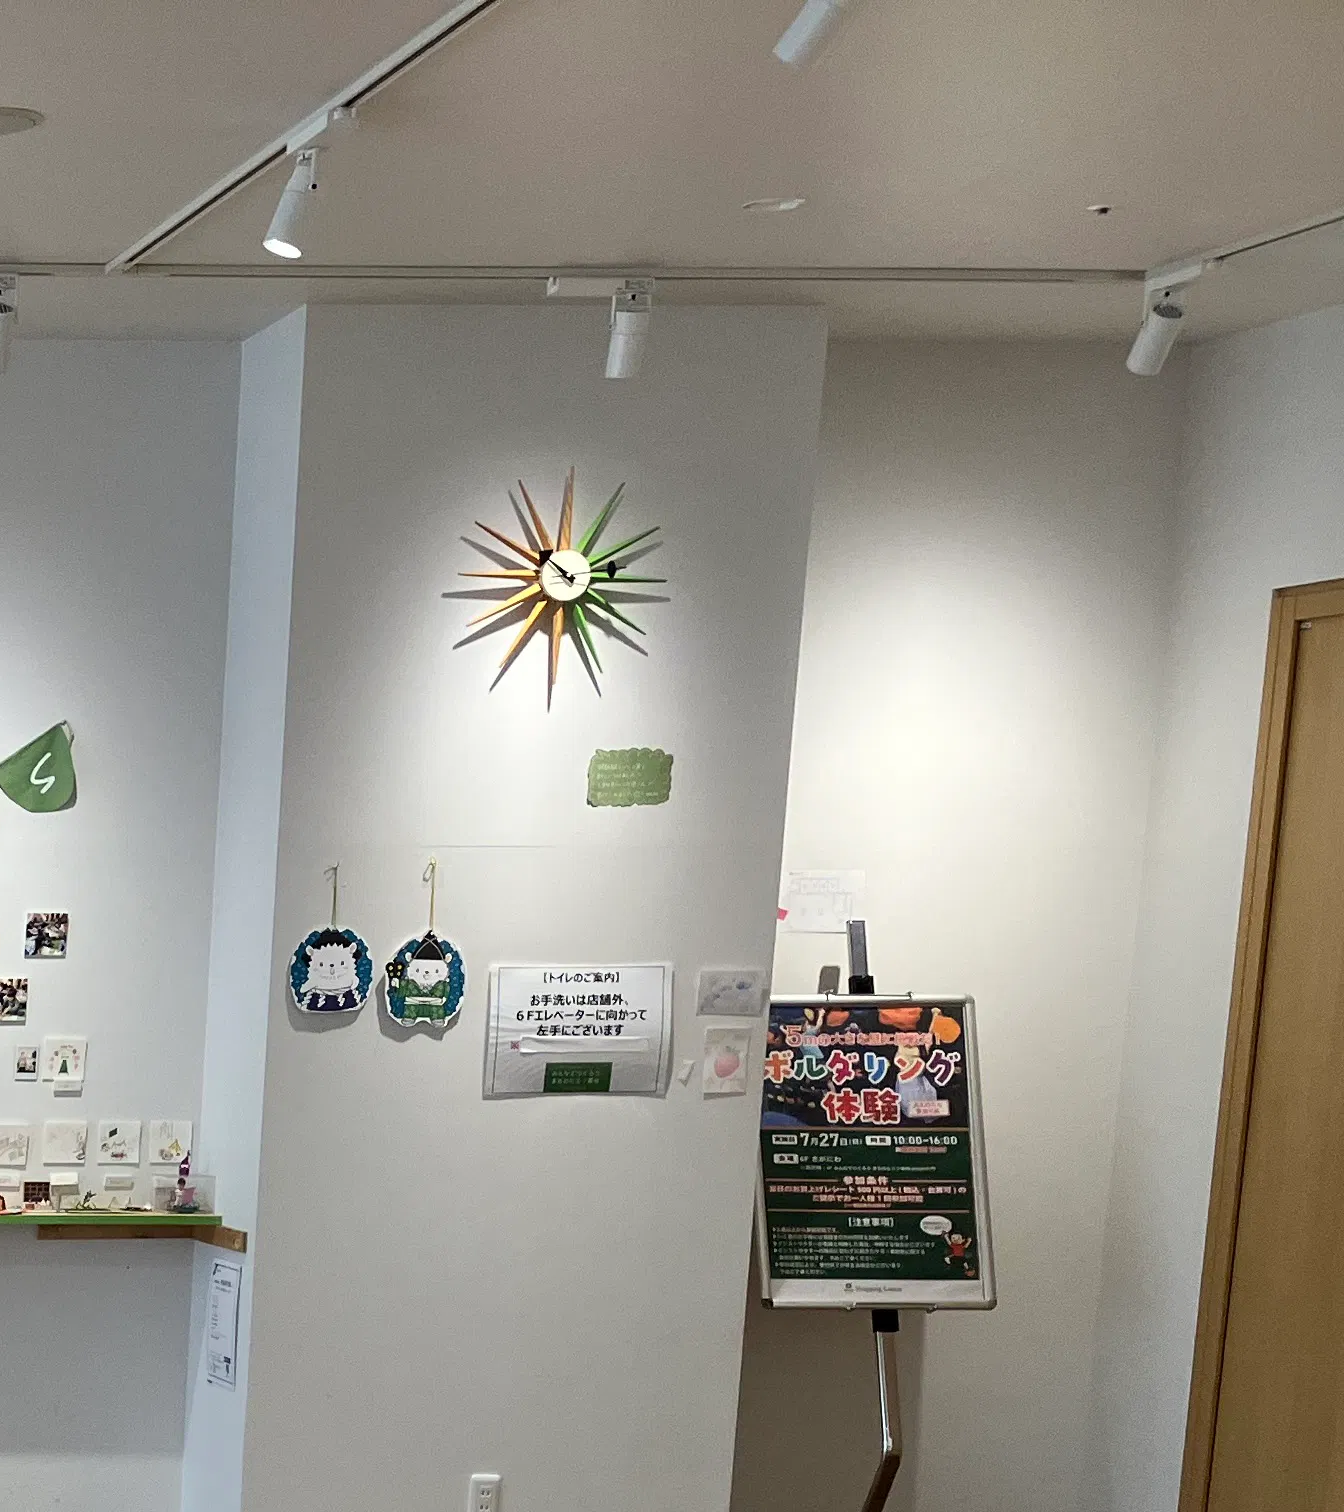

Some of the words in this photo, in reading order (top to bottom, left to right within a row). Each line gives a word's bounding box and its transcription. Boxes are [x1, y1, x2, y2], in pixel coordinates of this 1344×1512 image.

[536, 1024, 625, 1036] 左手にございます
[764, 1049, 961, 1086] ボルダリング
[820, 1088, 901, 1124] 体験
